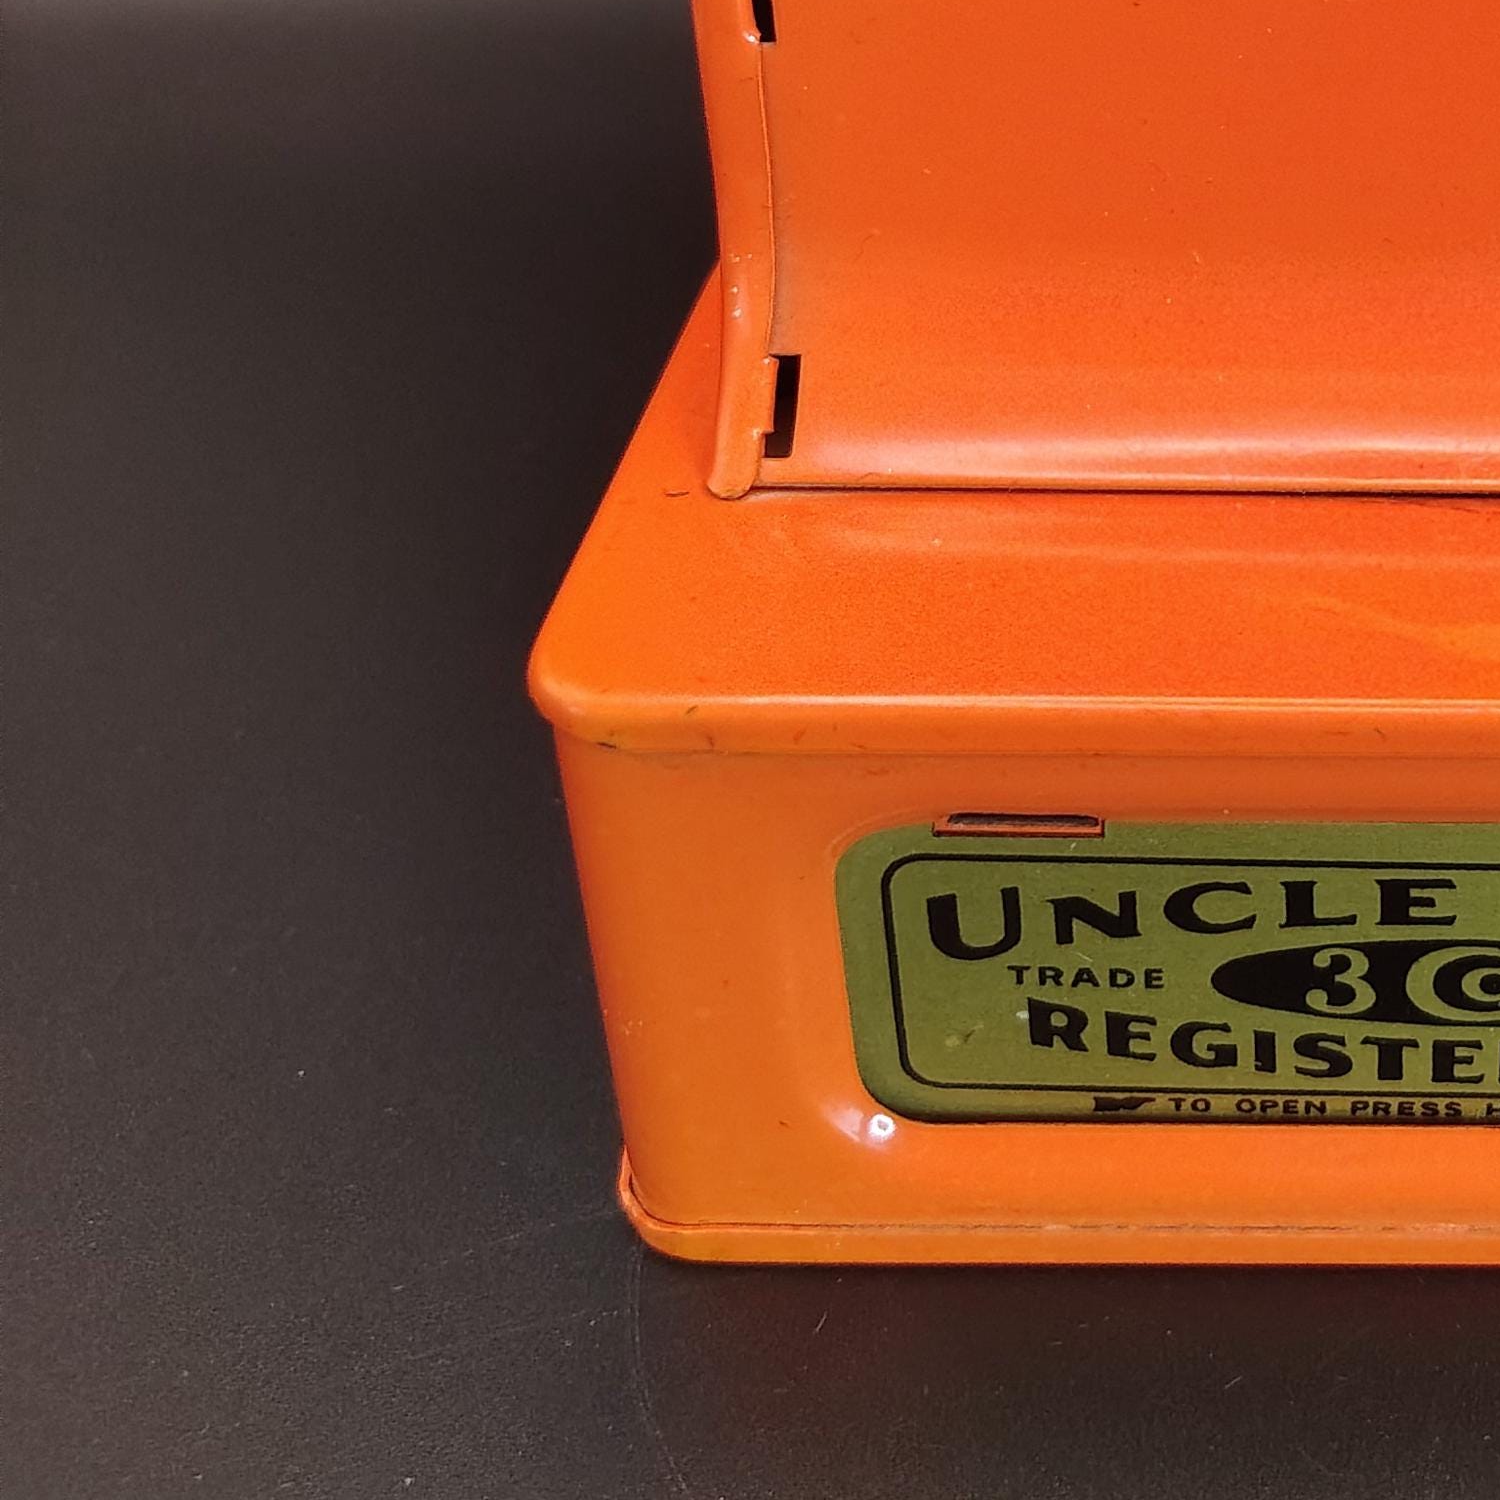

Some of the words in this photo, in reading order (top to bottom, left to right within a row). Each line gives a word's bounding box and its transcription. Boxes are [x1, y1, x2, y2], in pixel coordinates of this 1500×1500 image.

[926, 878, 1457, 962] UNCLE
[1006, 964, 1166, 990] TRADE
[1305, 947, 1377, 1016] 3
[1167, 1097, 1212, 1113] TO
[1234, 1097, 1328, 1116] OPEN
[1349, 1100, 1465, 1118] PRESS
